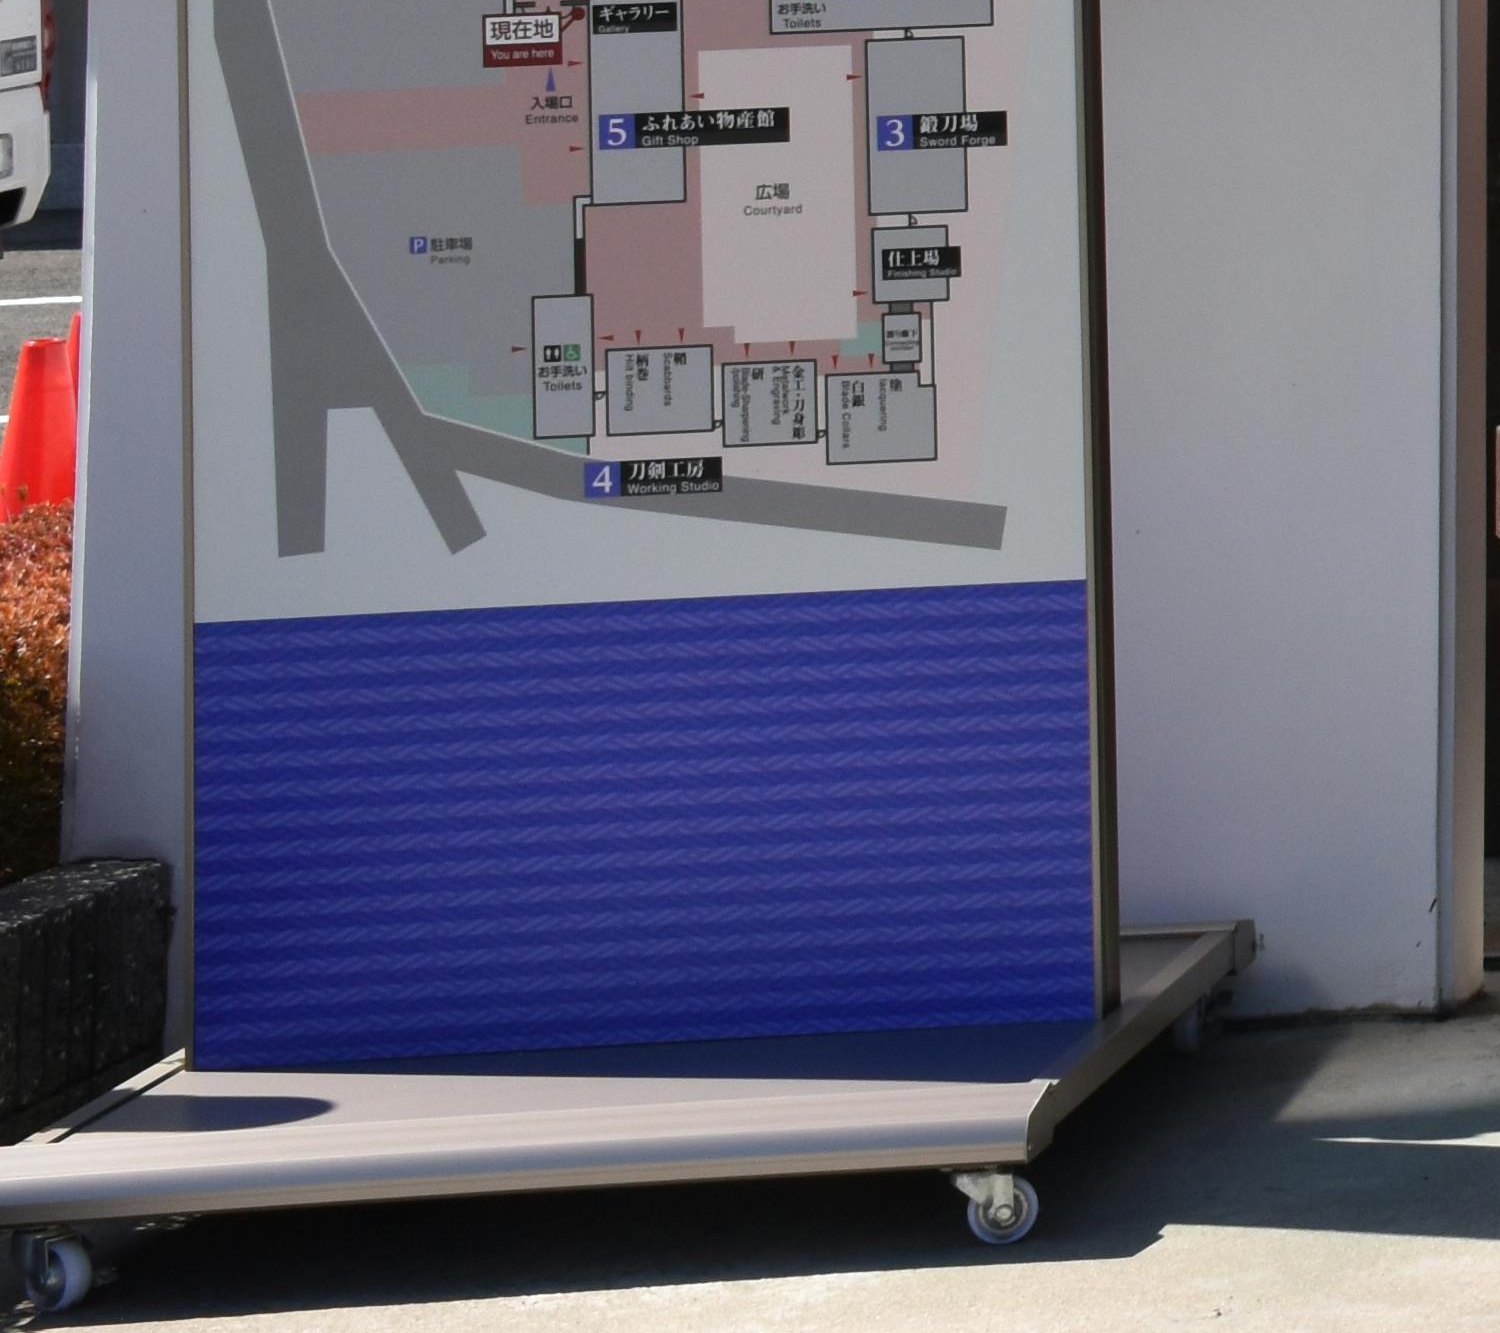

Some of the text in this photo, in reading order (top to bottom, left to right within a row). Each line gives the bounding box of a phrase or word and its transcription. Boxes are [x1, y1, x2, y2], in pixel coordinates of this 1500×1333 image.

[599, 4, 670, 22] ギャラリー
[777, 2, 827, 16] お手洗い
[490, 19, 554, 41] 現在地
[783, 17, 822, 29] Toilets
[490, 47, 555, 61] You are here
[530, 95, 573, 111] 入場口
[524, 112, 579, 126] Entrance
[641, 109, 776, 132] ふれあい物産館
[606, 118, 628, 146] 5
[641, 133, 700, 147] Gift Shop
[884, 119, 906, 147] 3
[919, 132, 996, 147] Sword Forge
[755, 183, 790, 201] 広場
[743, 202, 803, 217] Courtyard
[430, 237, 473, 252] 駐車場
[430, 254, 471, 266] Parking
[888, 248, 940, 268] 仕上場
[538, 365, 588, 380] お手洗い
[663, 351, 673, 407] Scabbards
[543, 380, 583, 393] Toilets
[623, 353, 635, 412] Hilt binding
[770, 376, 781, 425] Engraving
[841, 380, 852, 449] Blade Collars
[628, 459, 706, 481] 刀剣工房
[591, 464, 614, 494] 4
[627, 480, 720, 495] Working Studio
